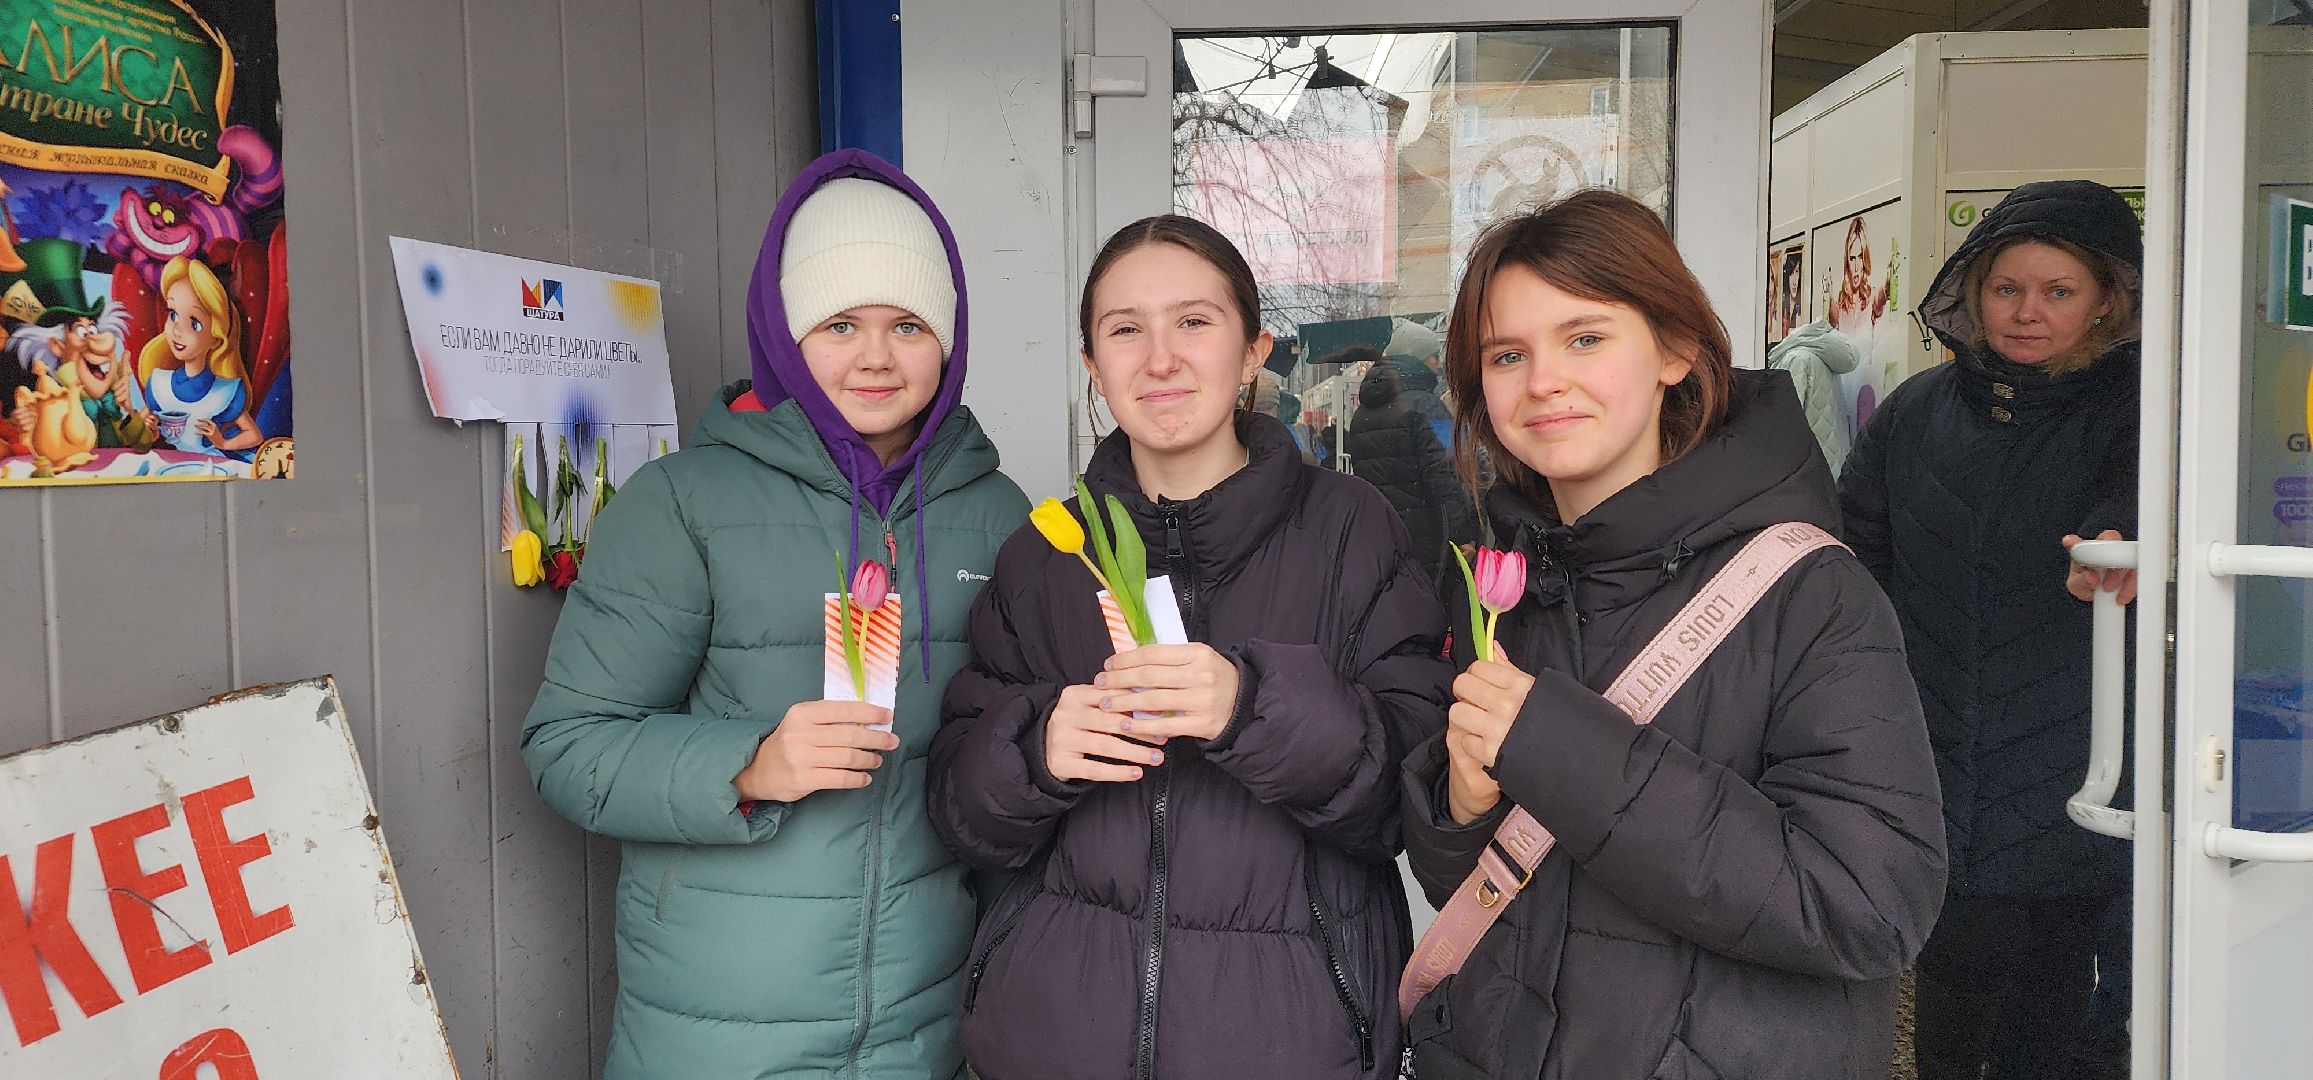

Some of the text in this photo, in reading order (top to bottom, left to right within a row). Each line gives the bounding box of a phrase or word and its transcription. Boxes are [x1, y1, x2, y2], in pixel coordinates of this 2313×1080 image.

[122, 101, 209, 151] Чудес
[164, 163, 209, 186] сказка
[526, 307, 561, 321] ШАТУРА
[440, 324, 472, 350] ЕСЛИ
[473, 328, 501, 352] ВАМ
[503, 331, 540, 356] ДАВНО
[541, 335, 556, 357] НЕ
[559, 337, 603, 360] ДАРИЛИ
[483, 355, 611, 379] ТОГДА ПОРАДУЙТЕ СЕБЯ САМИ!
[1678, 594, 1736, 652] LOUIS
